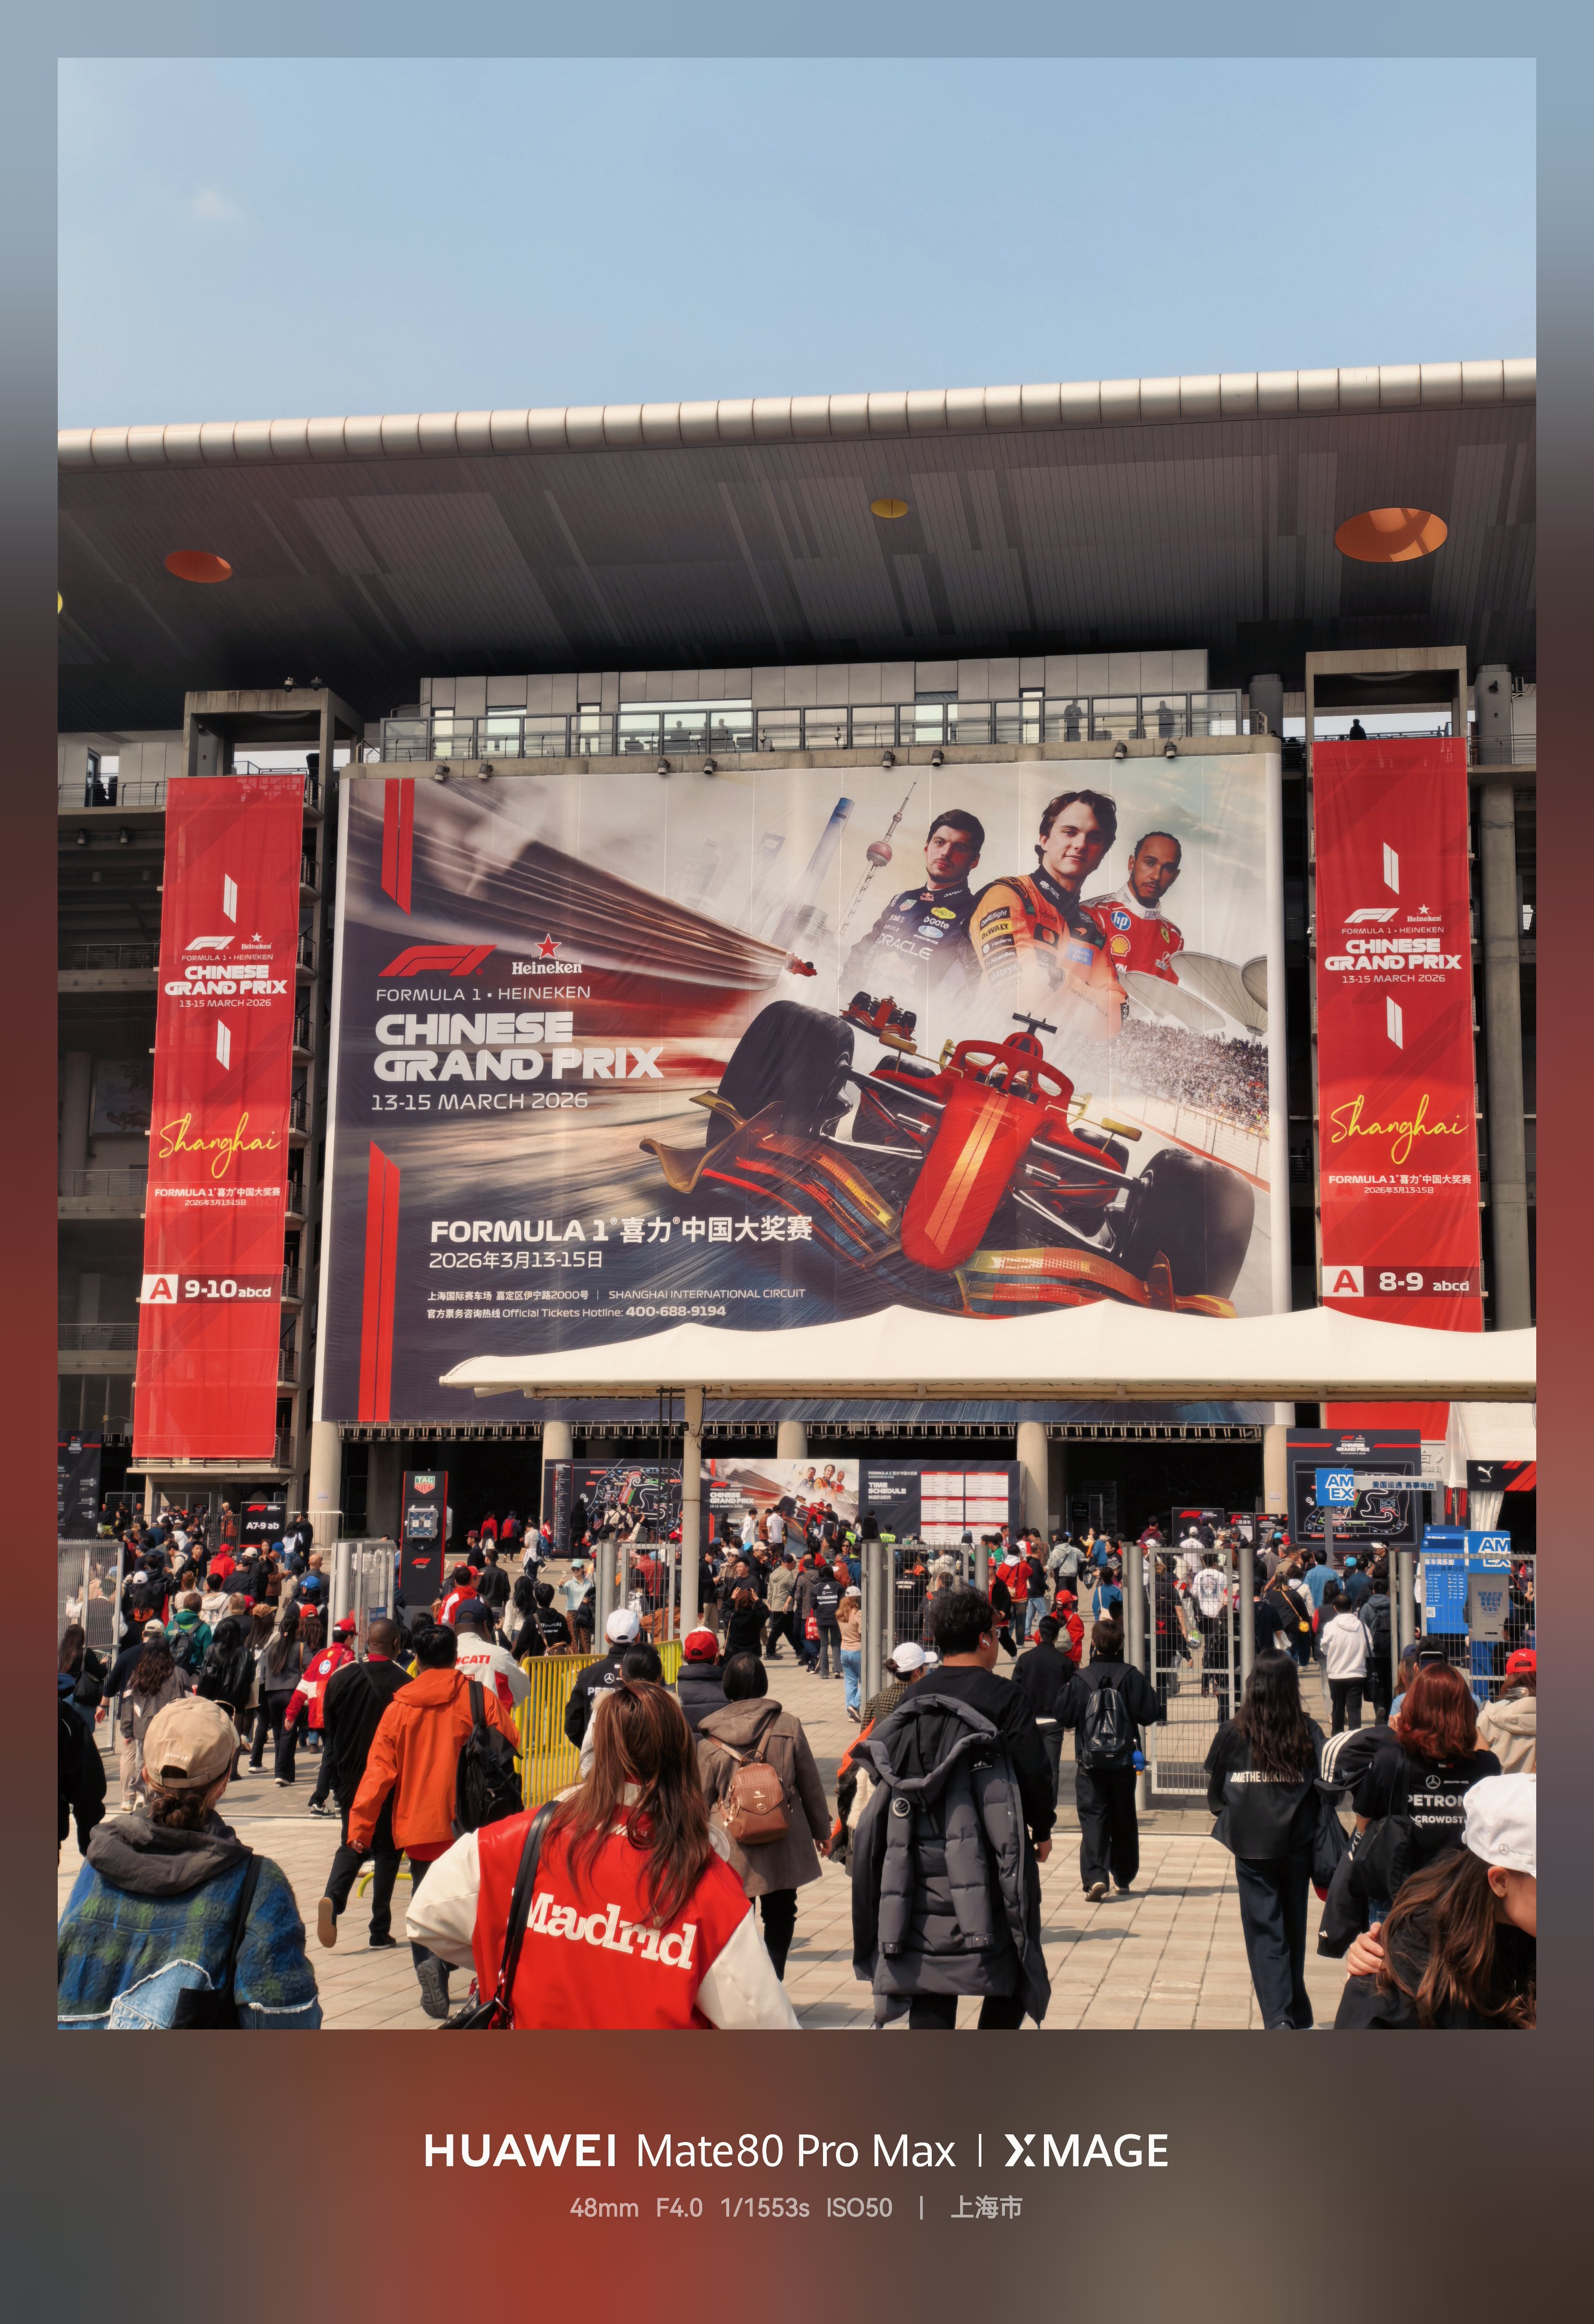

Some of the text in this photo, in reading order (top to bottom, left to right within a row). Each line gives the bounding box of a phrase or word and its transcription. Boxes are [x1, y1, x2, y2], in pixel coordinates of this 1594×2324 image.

[1113, 912, 1129, 930] hp
[877, 933, 933, 960] ORACLE
[1346, 938, 1440, 954] CHINESE
[512, 961, 582, 975] Heineken
[1324, 955, 1463, 970] GRAND PRIX
[185, 965, 269, 980] CHINESE
[165, 980, 288, 995] GRAND PRIX
[376, 986, 590, 1001] FORMULA 1 HEINEKEN
[375, 1011, 573, 1045] CHINESE
[373, 1046, 665, 1082] GRAND PRIX
[373, 1092, 588, 1110] 13-15 MARCH 2026
[1330, 1094, 1469, 1164] Shanghai
[159, 1111, 283, 1179] Shanghai
[154, 1188, 206, 1197] FORMULA
[431, 1219, 586, 1242] FORMULA
[429, 1251, 603, 1269] 2026年3月13-15日
[149, 1277, 173, 1300] A
[1333, 1269, 1469, 1293] A 8-9 abcd
[427, 1289, 806, 1301] 上海国际赛车场 嘉定区伊宁路2000号 SHANGHAI INTERNATIONAL CIRCUIT
[427, 1306, 726, 1318] 官方票务咨询热线 Official Tickets Hotline: 400-688-9194
[512, 1887, 697, 1970] Madrid
